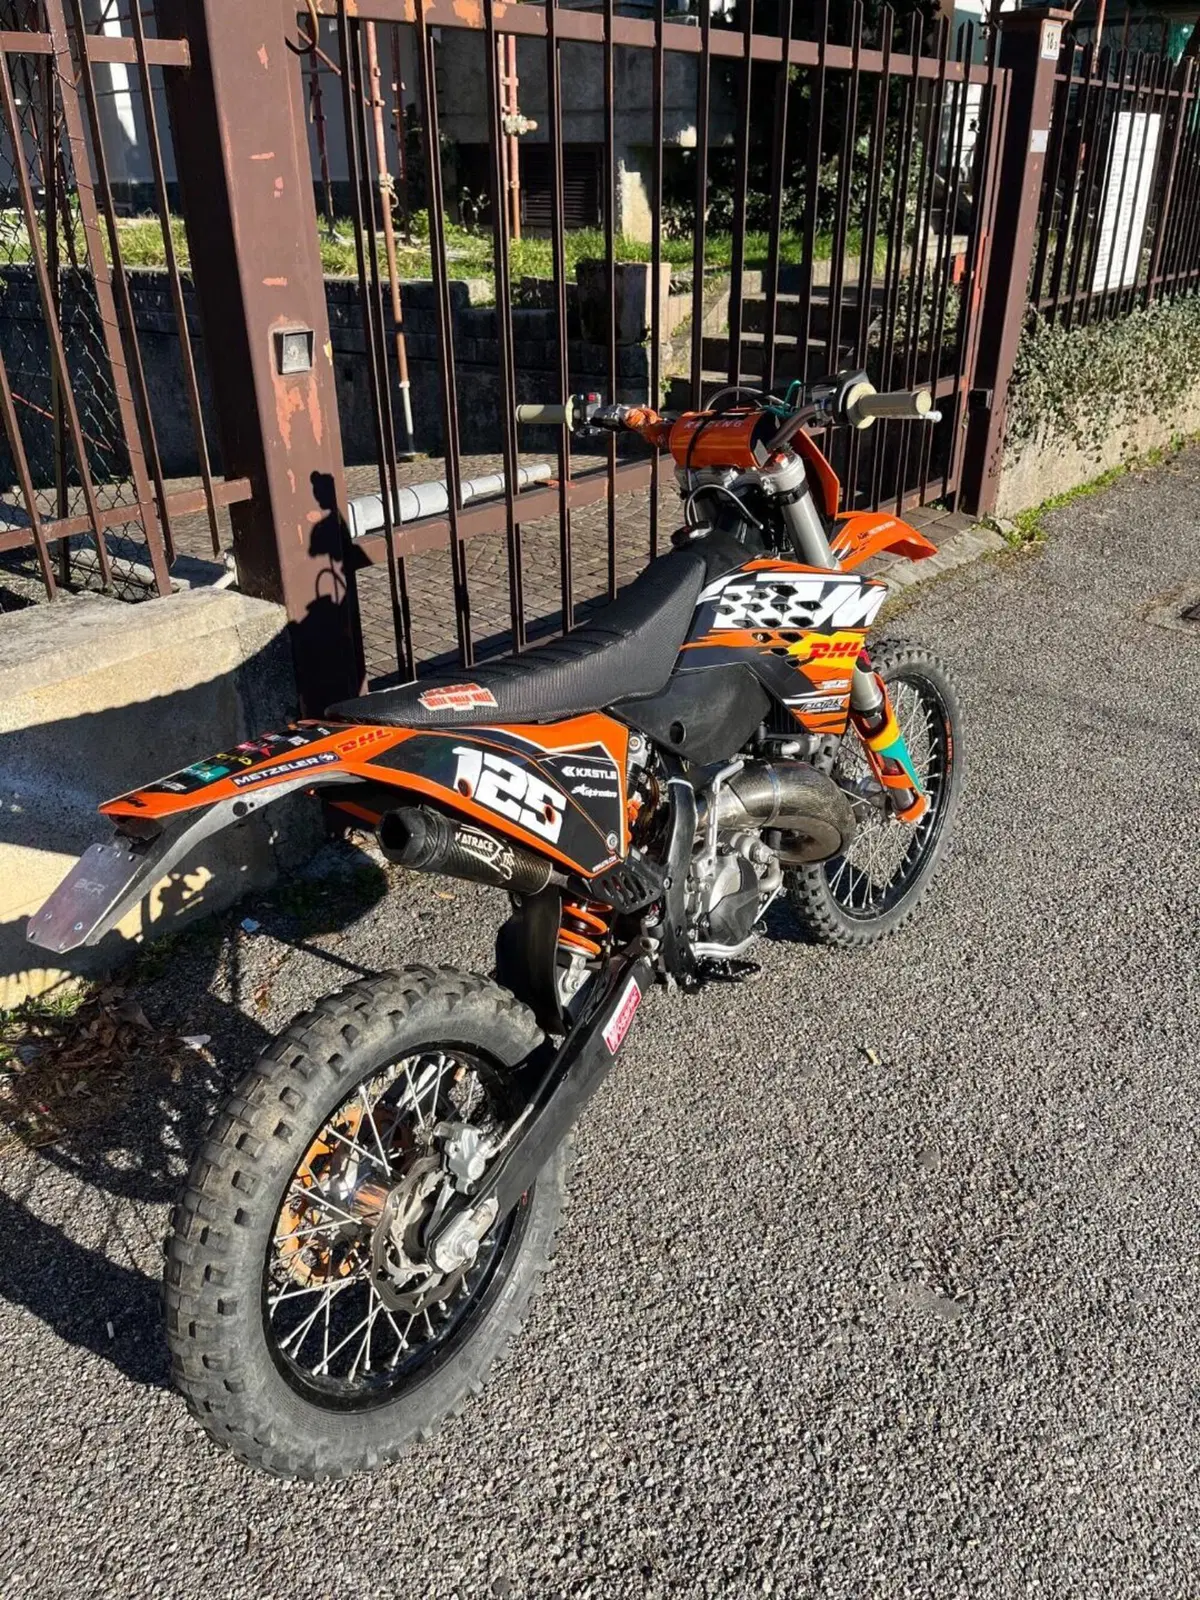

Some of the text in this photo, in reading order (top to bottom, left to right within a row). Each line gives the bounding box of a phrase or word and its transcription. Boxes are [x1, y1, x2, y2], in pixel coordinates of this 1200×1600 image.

[809, 642, 862, 659] DHL
[337, 729, 393, 753] DHL
[233, 756, 319, 786] METZELER
[452, 746, 567, 844] 125
